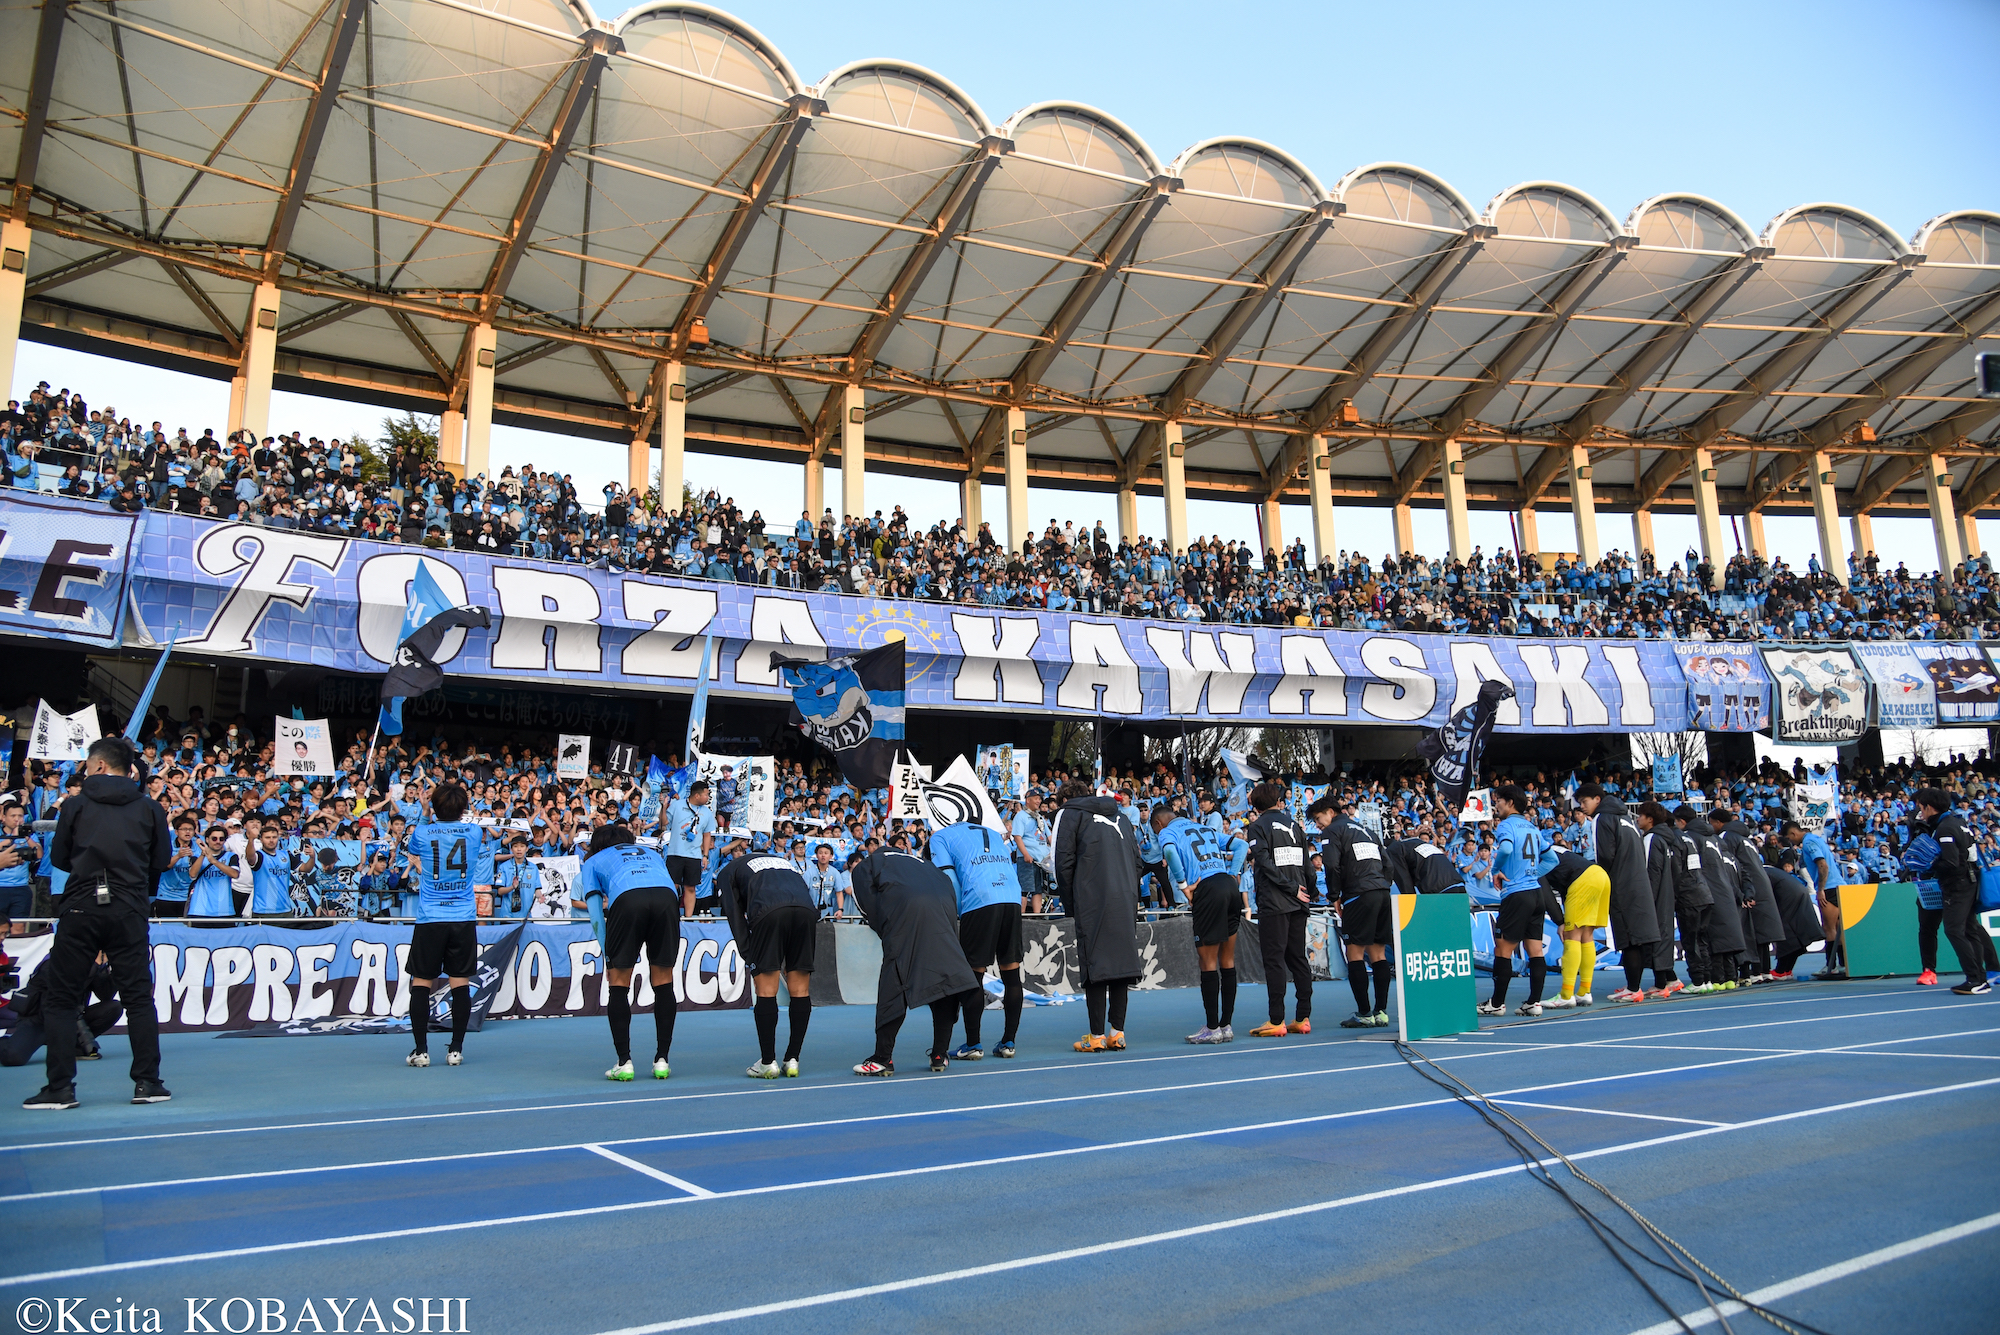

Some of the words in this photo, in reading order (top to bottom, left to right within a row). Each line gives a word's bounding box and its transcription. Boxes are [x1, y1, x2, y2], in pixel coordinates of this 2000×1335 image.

[168, 521, 829, 688] FORZA
[951, 612, 1656, 728] KAWASAKI
[1674, 644, 1701, 655] LOVE
[1702, 644, 1753, 656] KAWASAKI
[1856, 644, 1911, 657] TODOROKI
[1881, 703, 1935, 716] KAWASAKI
[291, 759, 316, 772] 優勝
[609, 744, 634, 774] 41
[900, 768, 921, 816] 強気
[1805, 801, 1829, 818] 26
[967, 825, 991, 853] 7
[1184, 827, 1223, 862] 23
[203, 867, 227, 880] UJITSU
[430, 838, 468, 881] 14
[434, 882, 467, 892] YASUTO
[564, 937, 746, 1011] FACO
[1406, 948, 1471, 983] 明治安田
